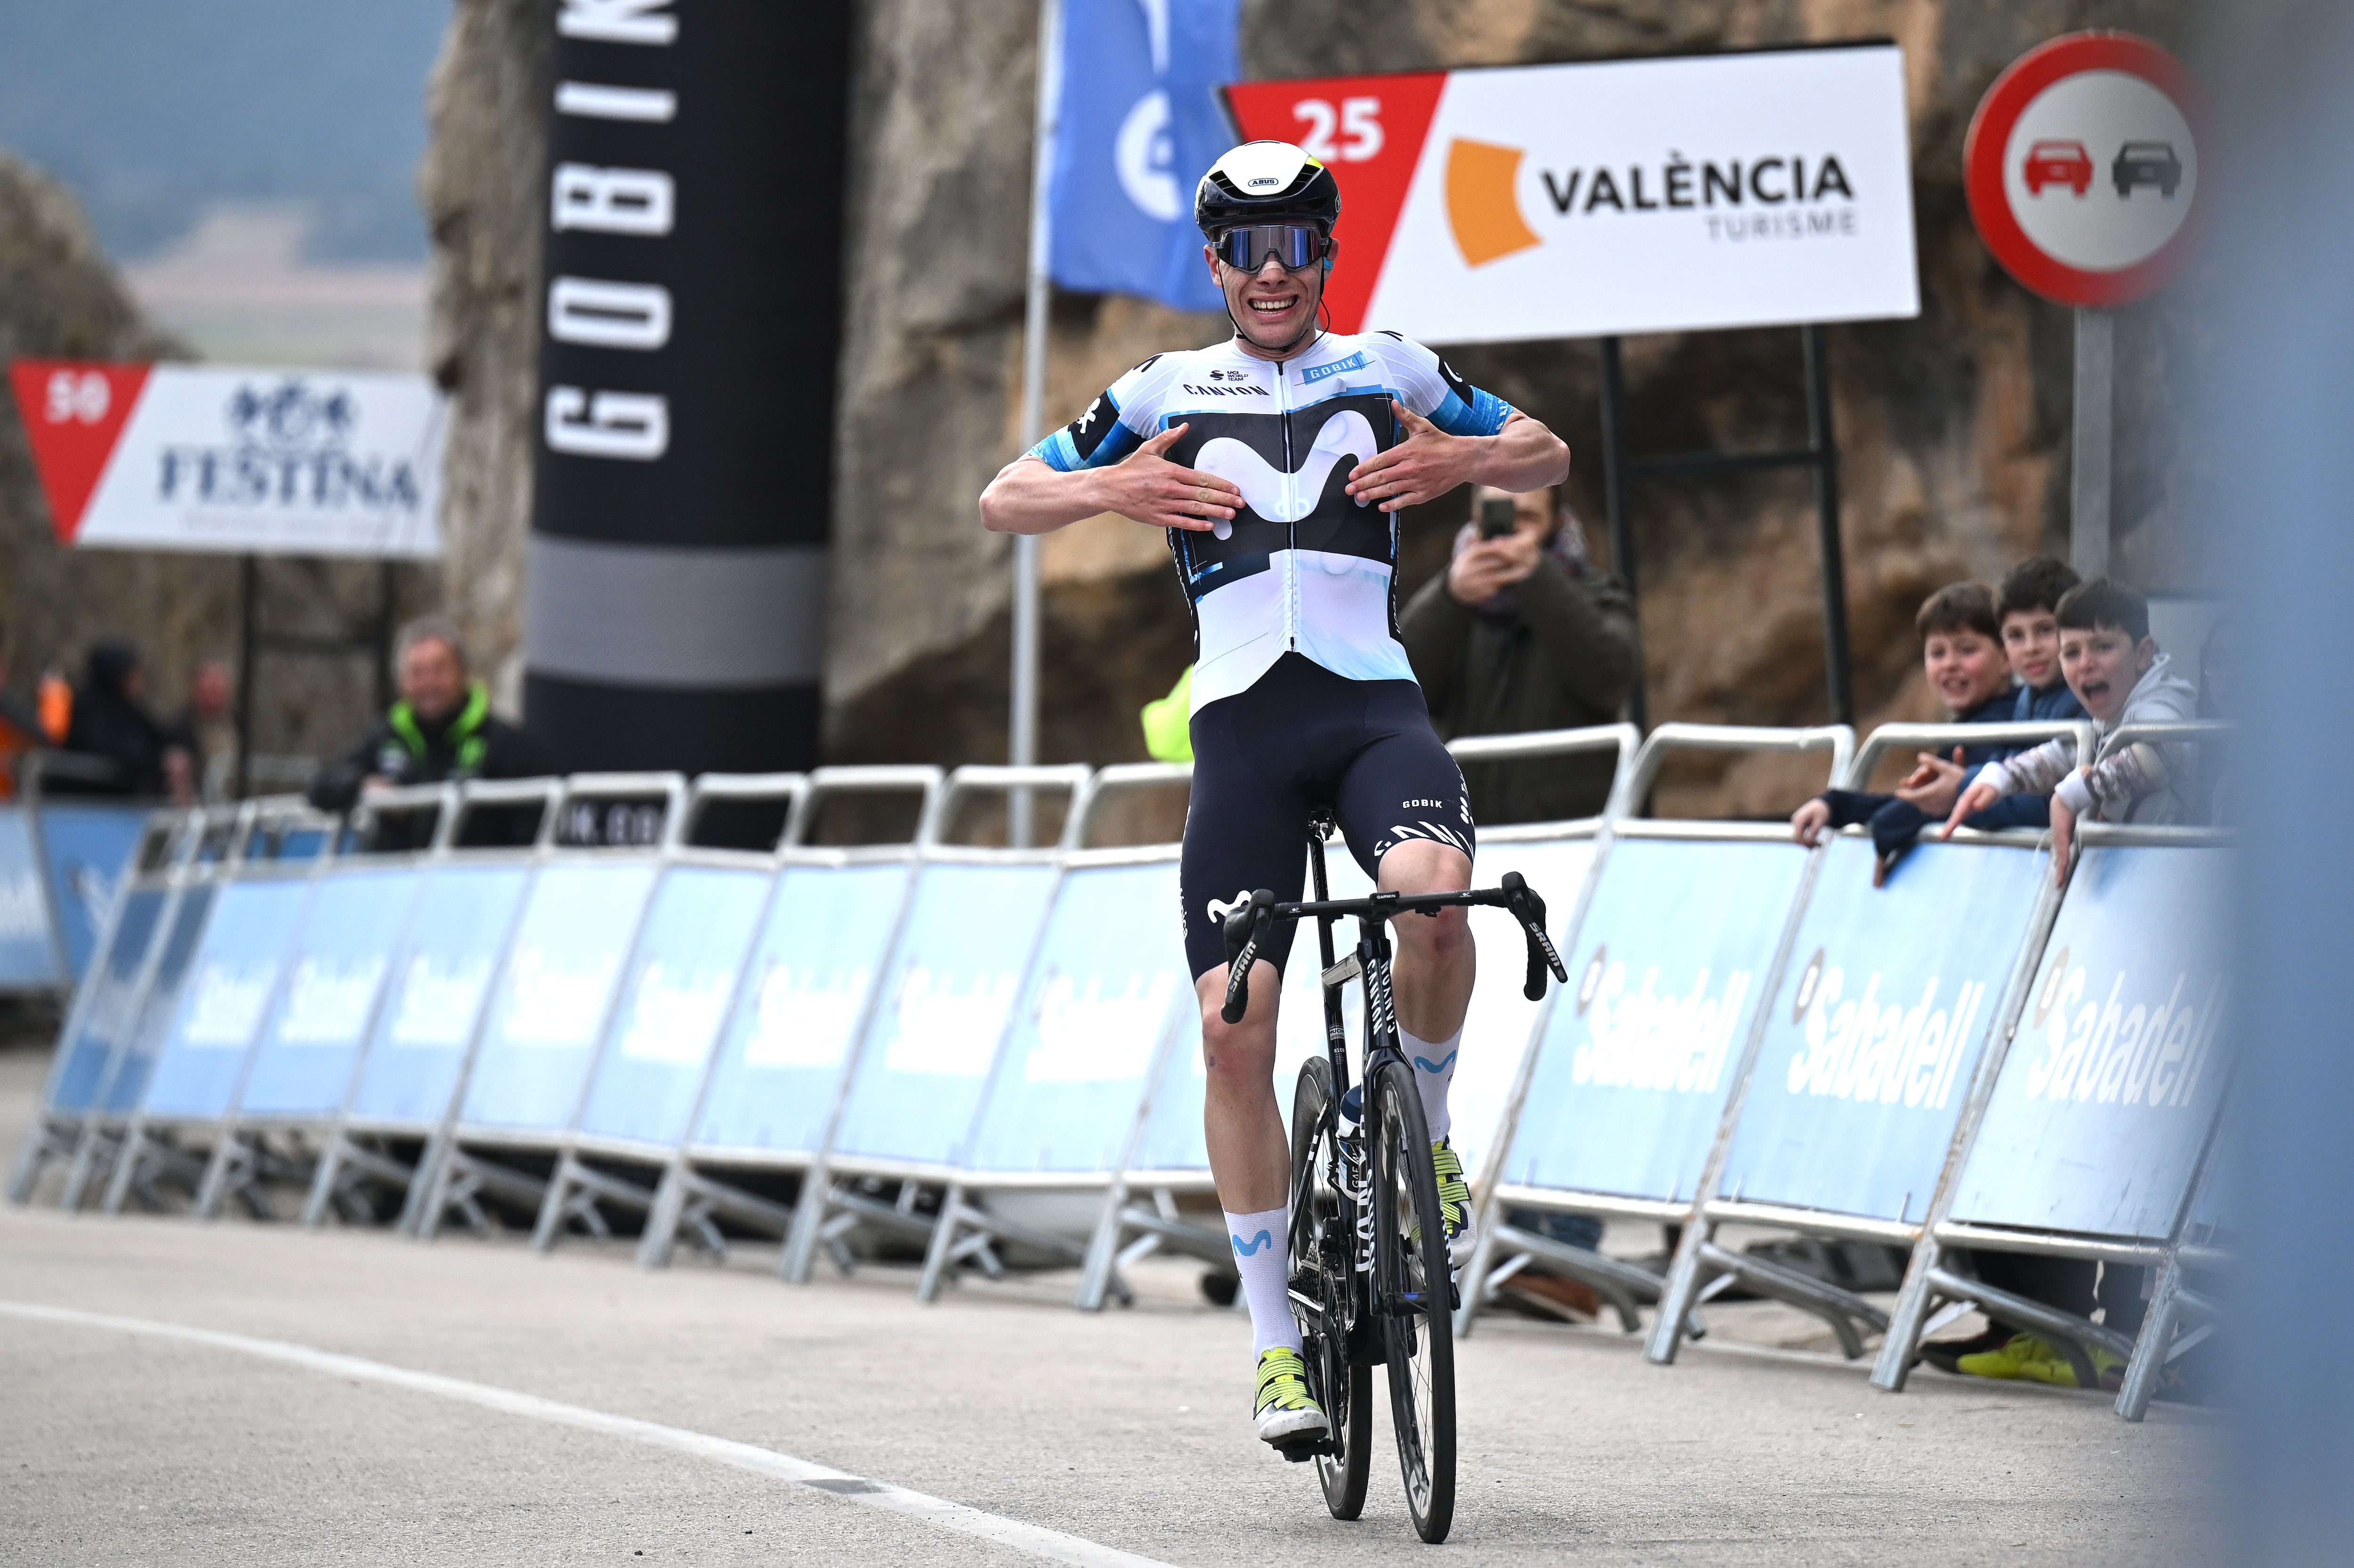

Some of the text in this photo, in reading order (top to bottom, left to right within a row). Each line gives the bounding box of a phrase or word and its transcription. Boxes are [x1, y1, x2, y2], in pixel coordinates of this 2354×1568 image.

[1292, 96, 1385, 162] 25
[1539, 149, 1856, 217] VALÈNCIA
[1706, 209, 1857, 243] TURISME
[45, 370, 111, 425] 50
[1309, 358, 1356, 378] GOBIK
[159, 444, 420, 513] FESTINA
[1403, 799, 1443, 809] GOBIK
[1229, 941, 1257, 993] SRAM
[1529, 922, 1560, 967] SRAM
[1367, 959, 1383, 1036] CANYON
[1381, 960, 1395, 1034] CANYON
[1787, 965, 1986, 1110] Sabadell
[2025, 965, 2230, 1108] Sabadell
